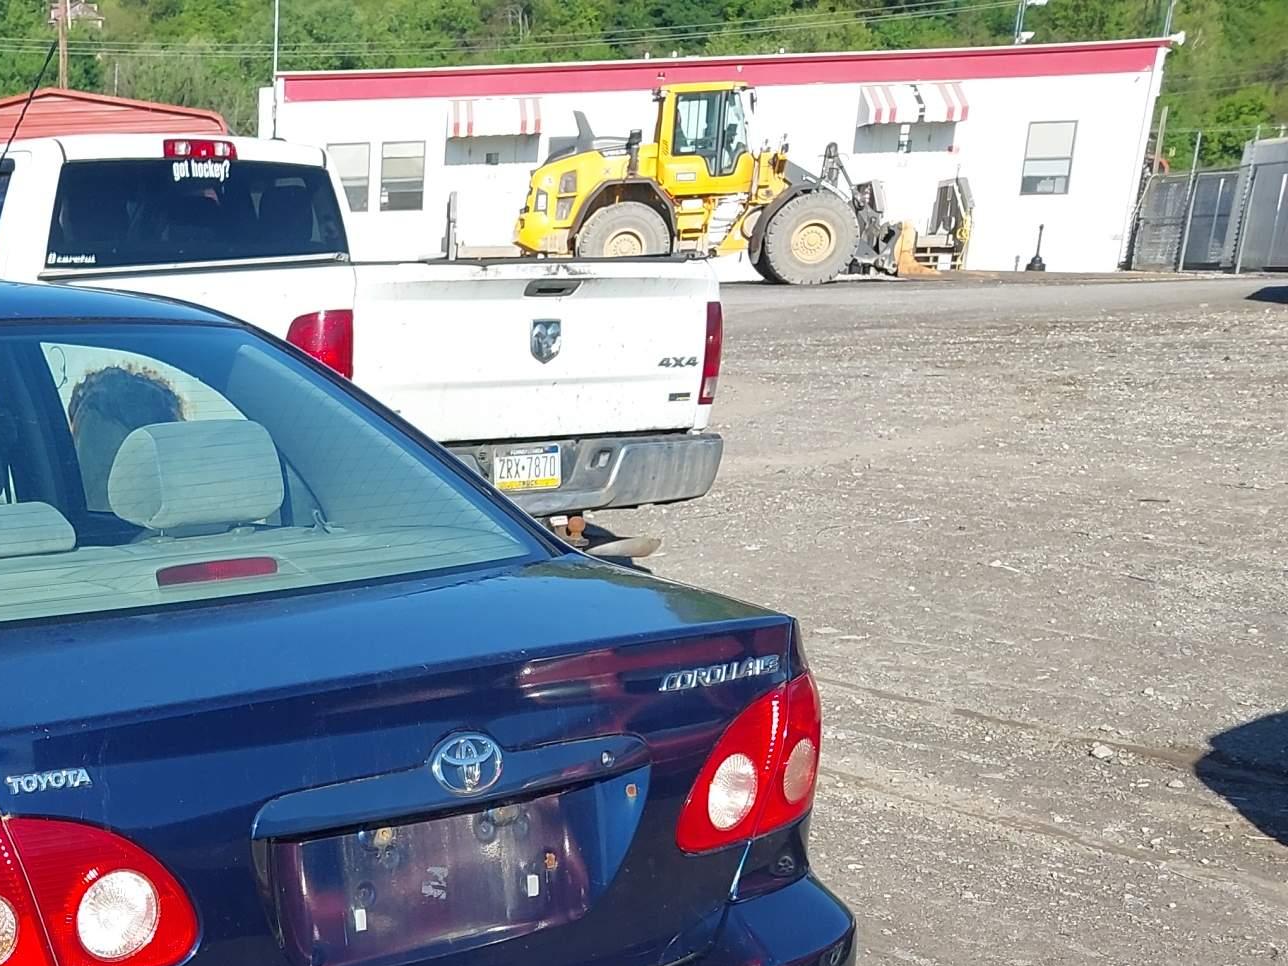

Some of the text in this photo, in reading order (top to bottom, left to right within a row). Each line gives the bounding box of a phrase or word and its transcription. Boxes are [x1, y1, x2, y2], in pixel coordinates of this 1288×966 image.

[173, 158, 231, 182] got hockey?
[657, 656, 760, 692] COROLLA
[5, 767, 92, 796] TOYOTA
